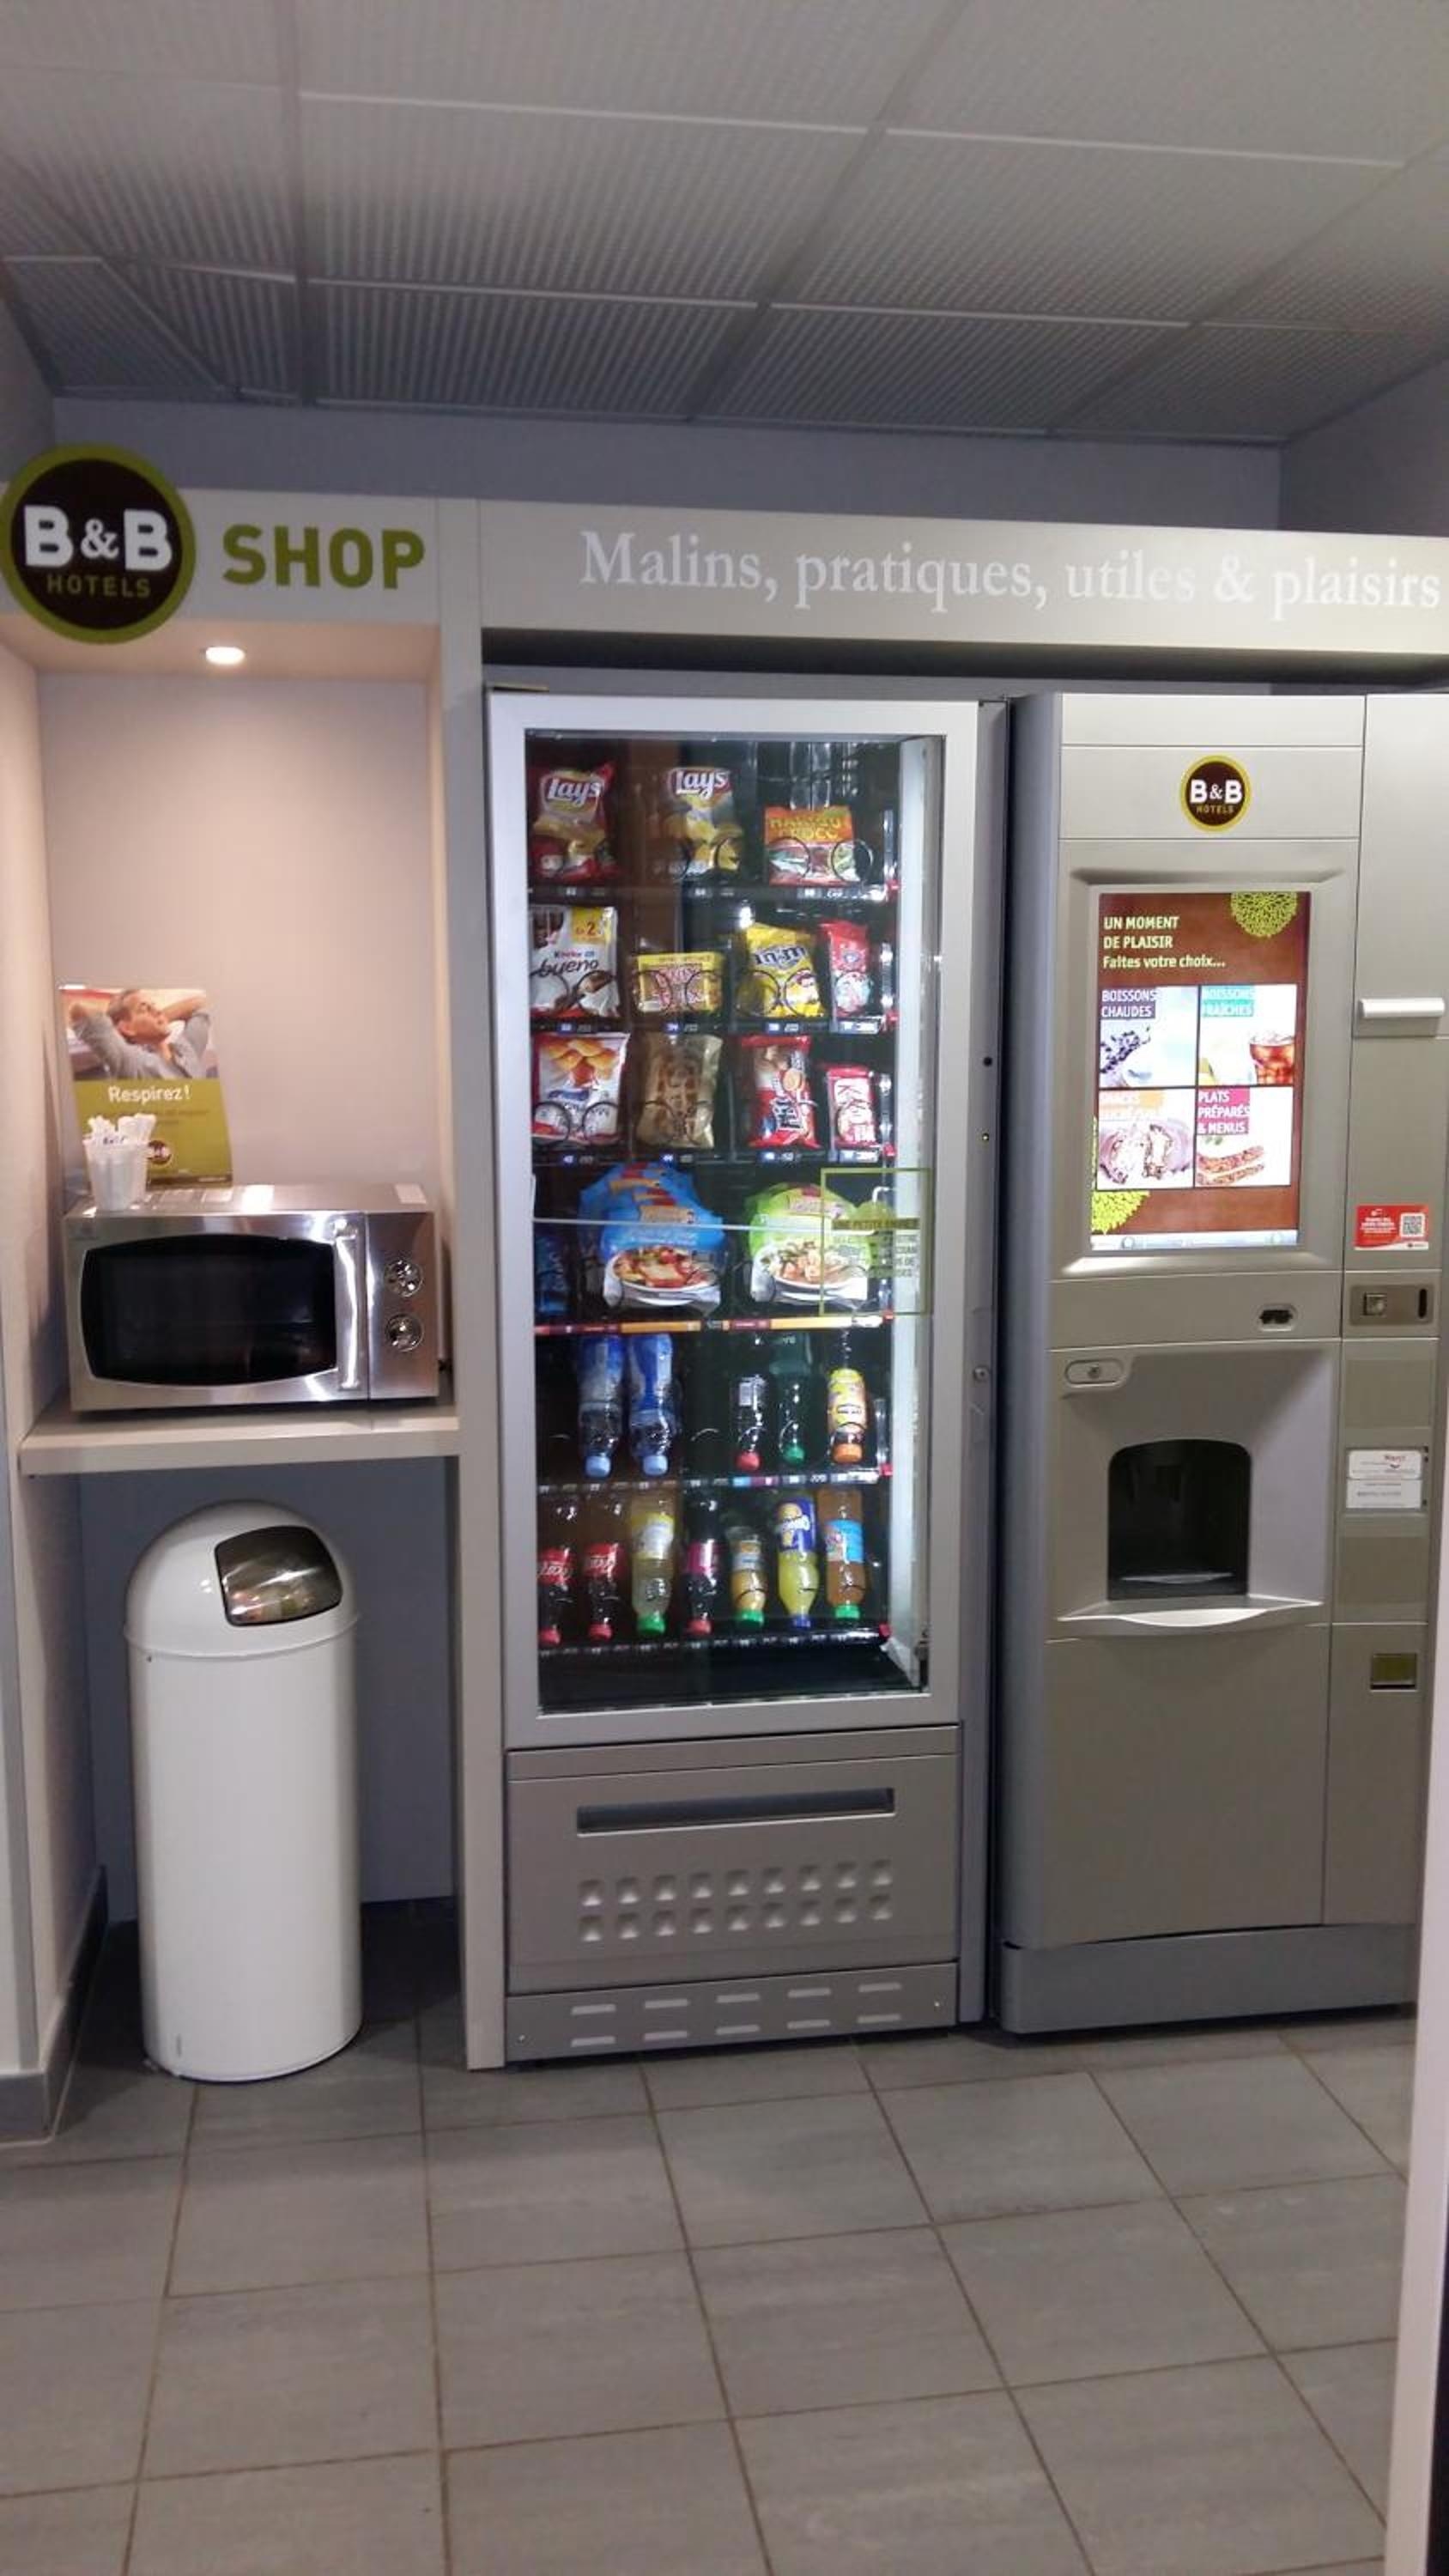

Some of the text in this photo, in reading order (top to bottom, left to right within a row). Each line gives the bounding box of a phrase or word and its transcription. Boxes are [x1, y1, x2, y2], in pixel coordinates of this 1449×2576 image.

[24, 505, 173, 572] B&B
[223, 524, 425, 589] SHOP
[579, 531, 1442, 621] Malins, pratiques, utiles & plaisirs
[46, 574, 151, 598] HOTELS
[1190, 779, 1243, 804] B&B
[1196, 805, 1234, 814] HOTELS
[1104, 915, 1179, 930] UN MOMENT
[1103, 935, 1173, 949] DE PLAISIR
[539, 959, 599, 978] bueno
[1102, 955, 1226, 969] Faites votre choix...
[1101, 989, 1156, 1002] BOISSONS
[1101, 1005, 1152, 1018] CHAUDES
[1198, 1090, 1230, 1103] PLATS
[1208, 1121, 1246, 1134] MENUS
